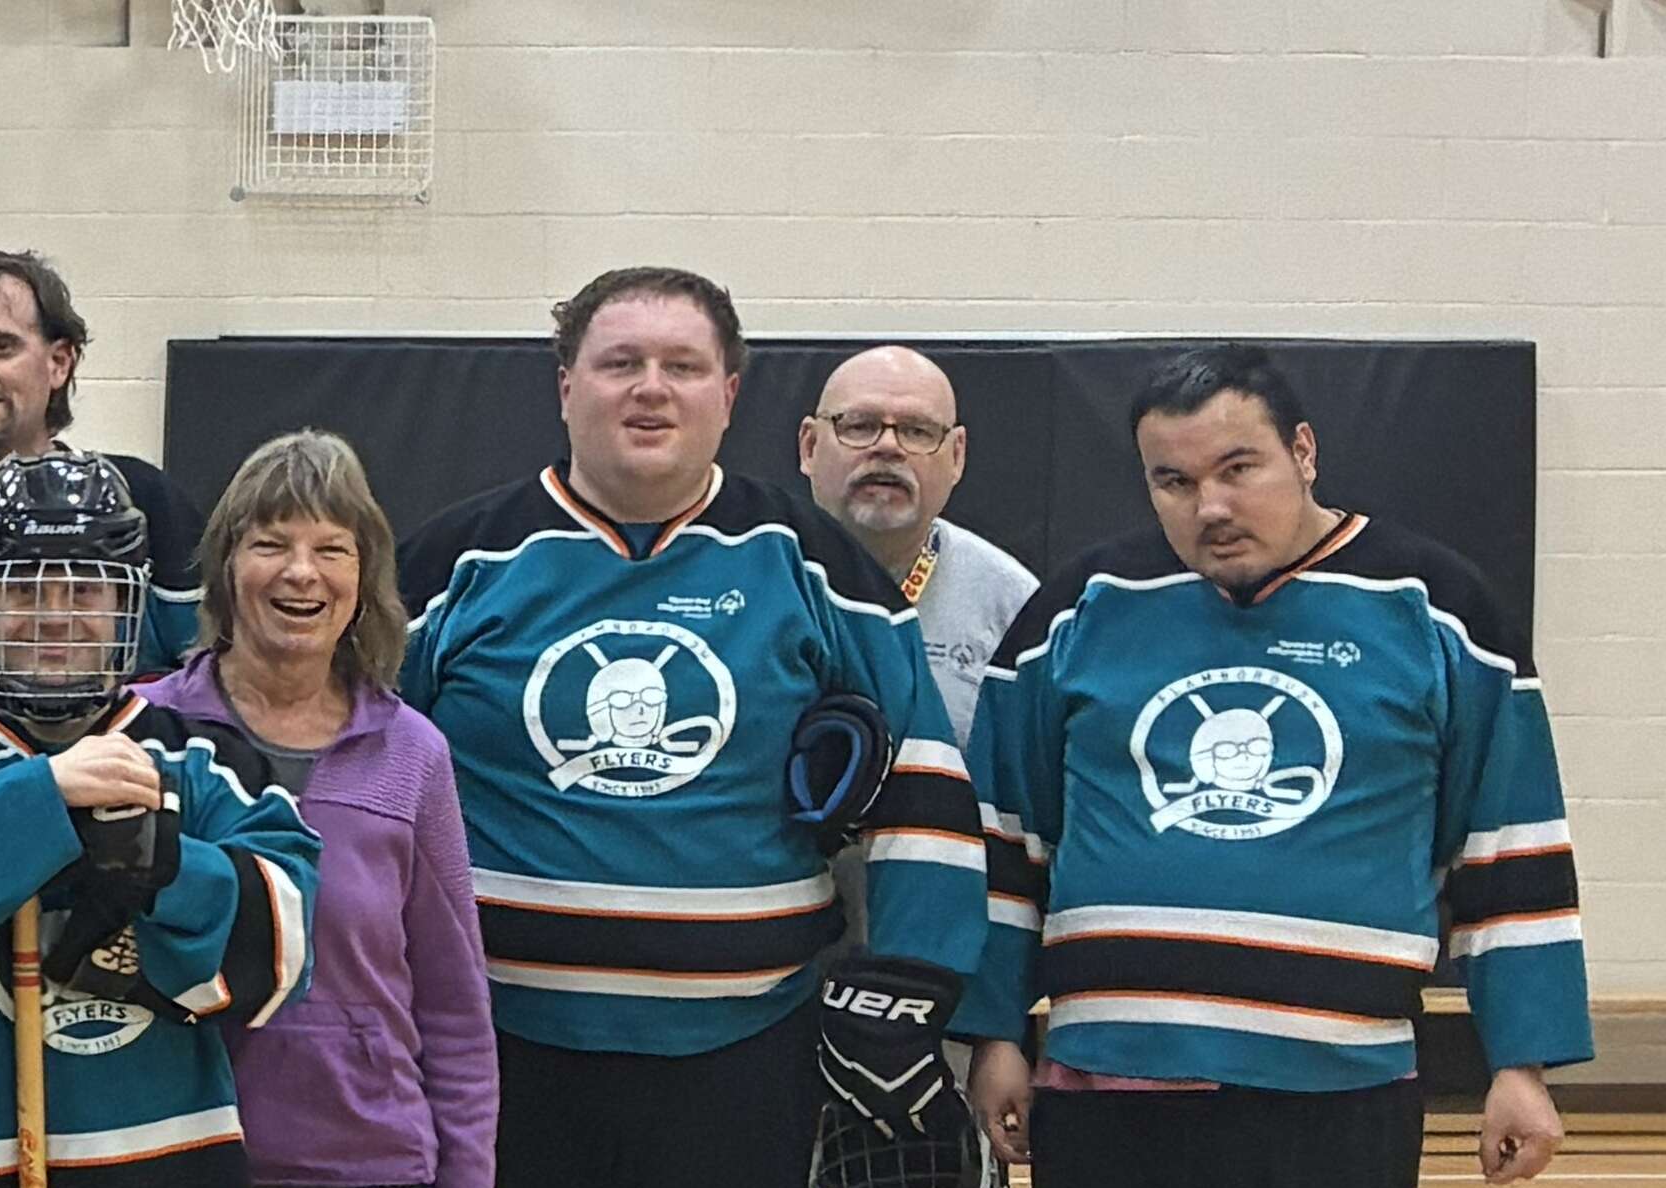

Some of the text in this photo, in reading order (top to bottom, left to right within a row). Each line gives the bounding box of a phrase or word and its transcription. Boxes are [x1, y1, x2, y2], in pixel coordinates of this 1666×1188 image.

[590, 752, 673, 769] FLYERS
[1191, 794, 1275, 814] FLYERS
[823, 981, 935, 1025] UER
[52, 1003, 128, 1026] FYERS
